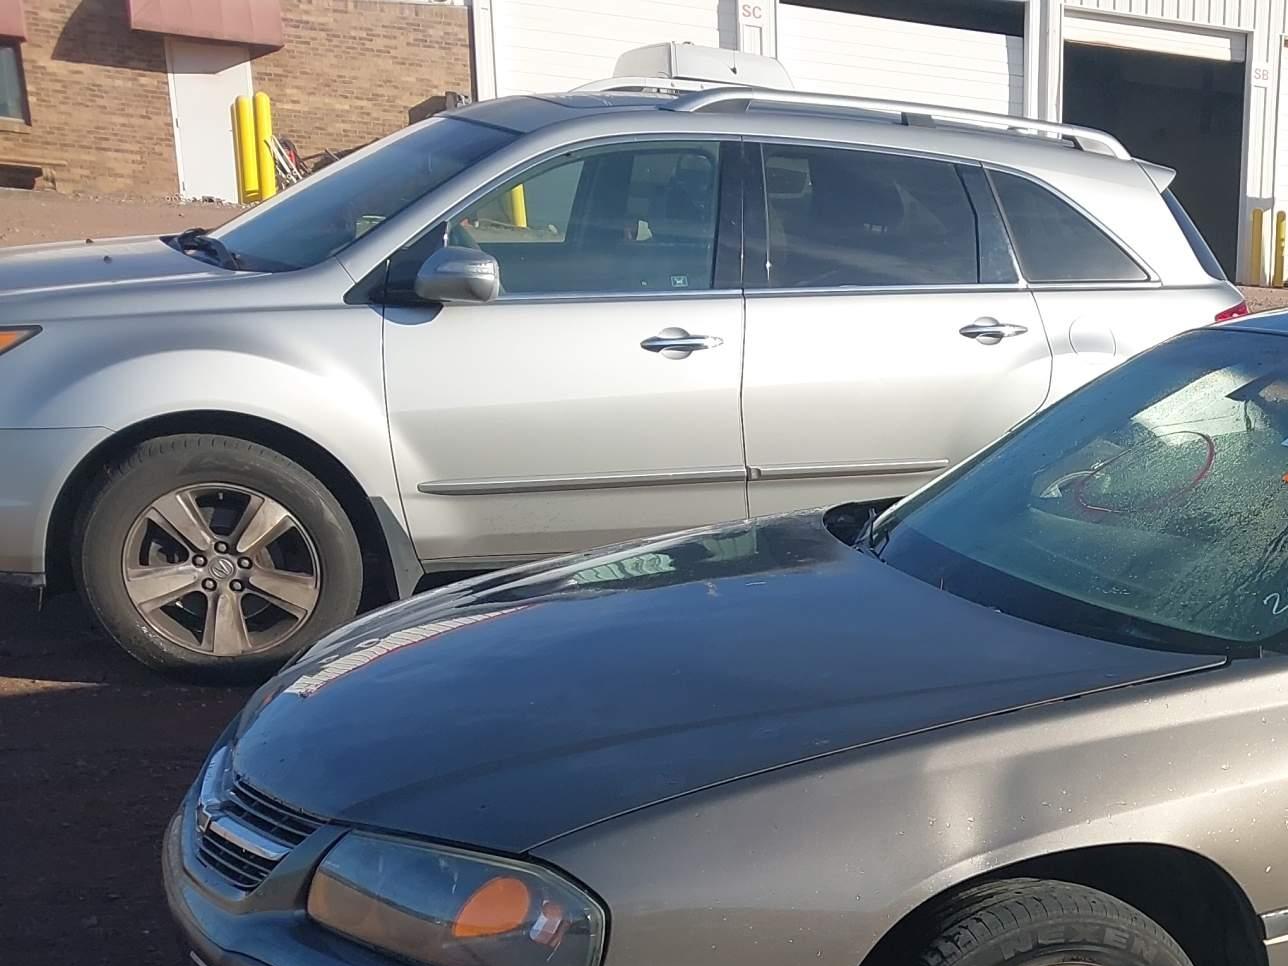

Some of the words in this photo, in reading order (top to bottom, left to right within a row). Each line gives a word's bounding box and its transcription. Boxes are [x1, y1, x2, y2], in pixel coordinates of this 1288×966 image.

[742, 4, 762, 19] SC
[1254, 68, 1269, 80] SB
[999, 923, 1161, 961] NEXEN
